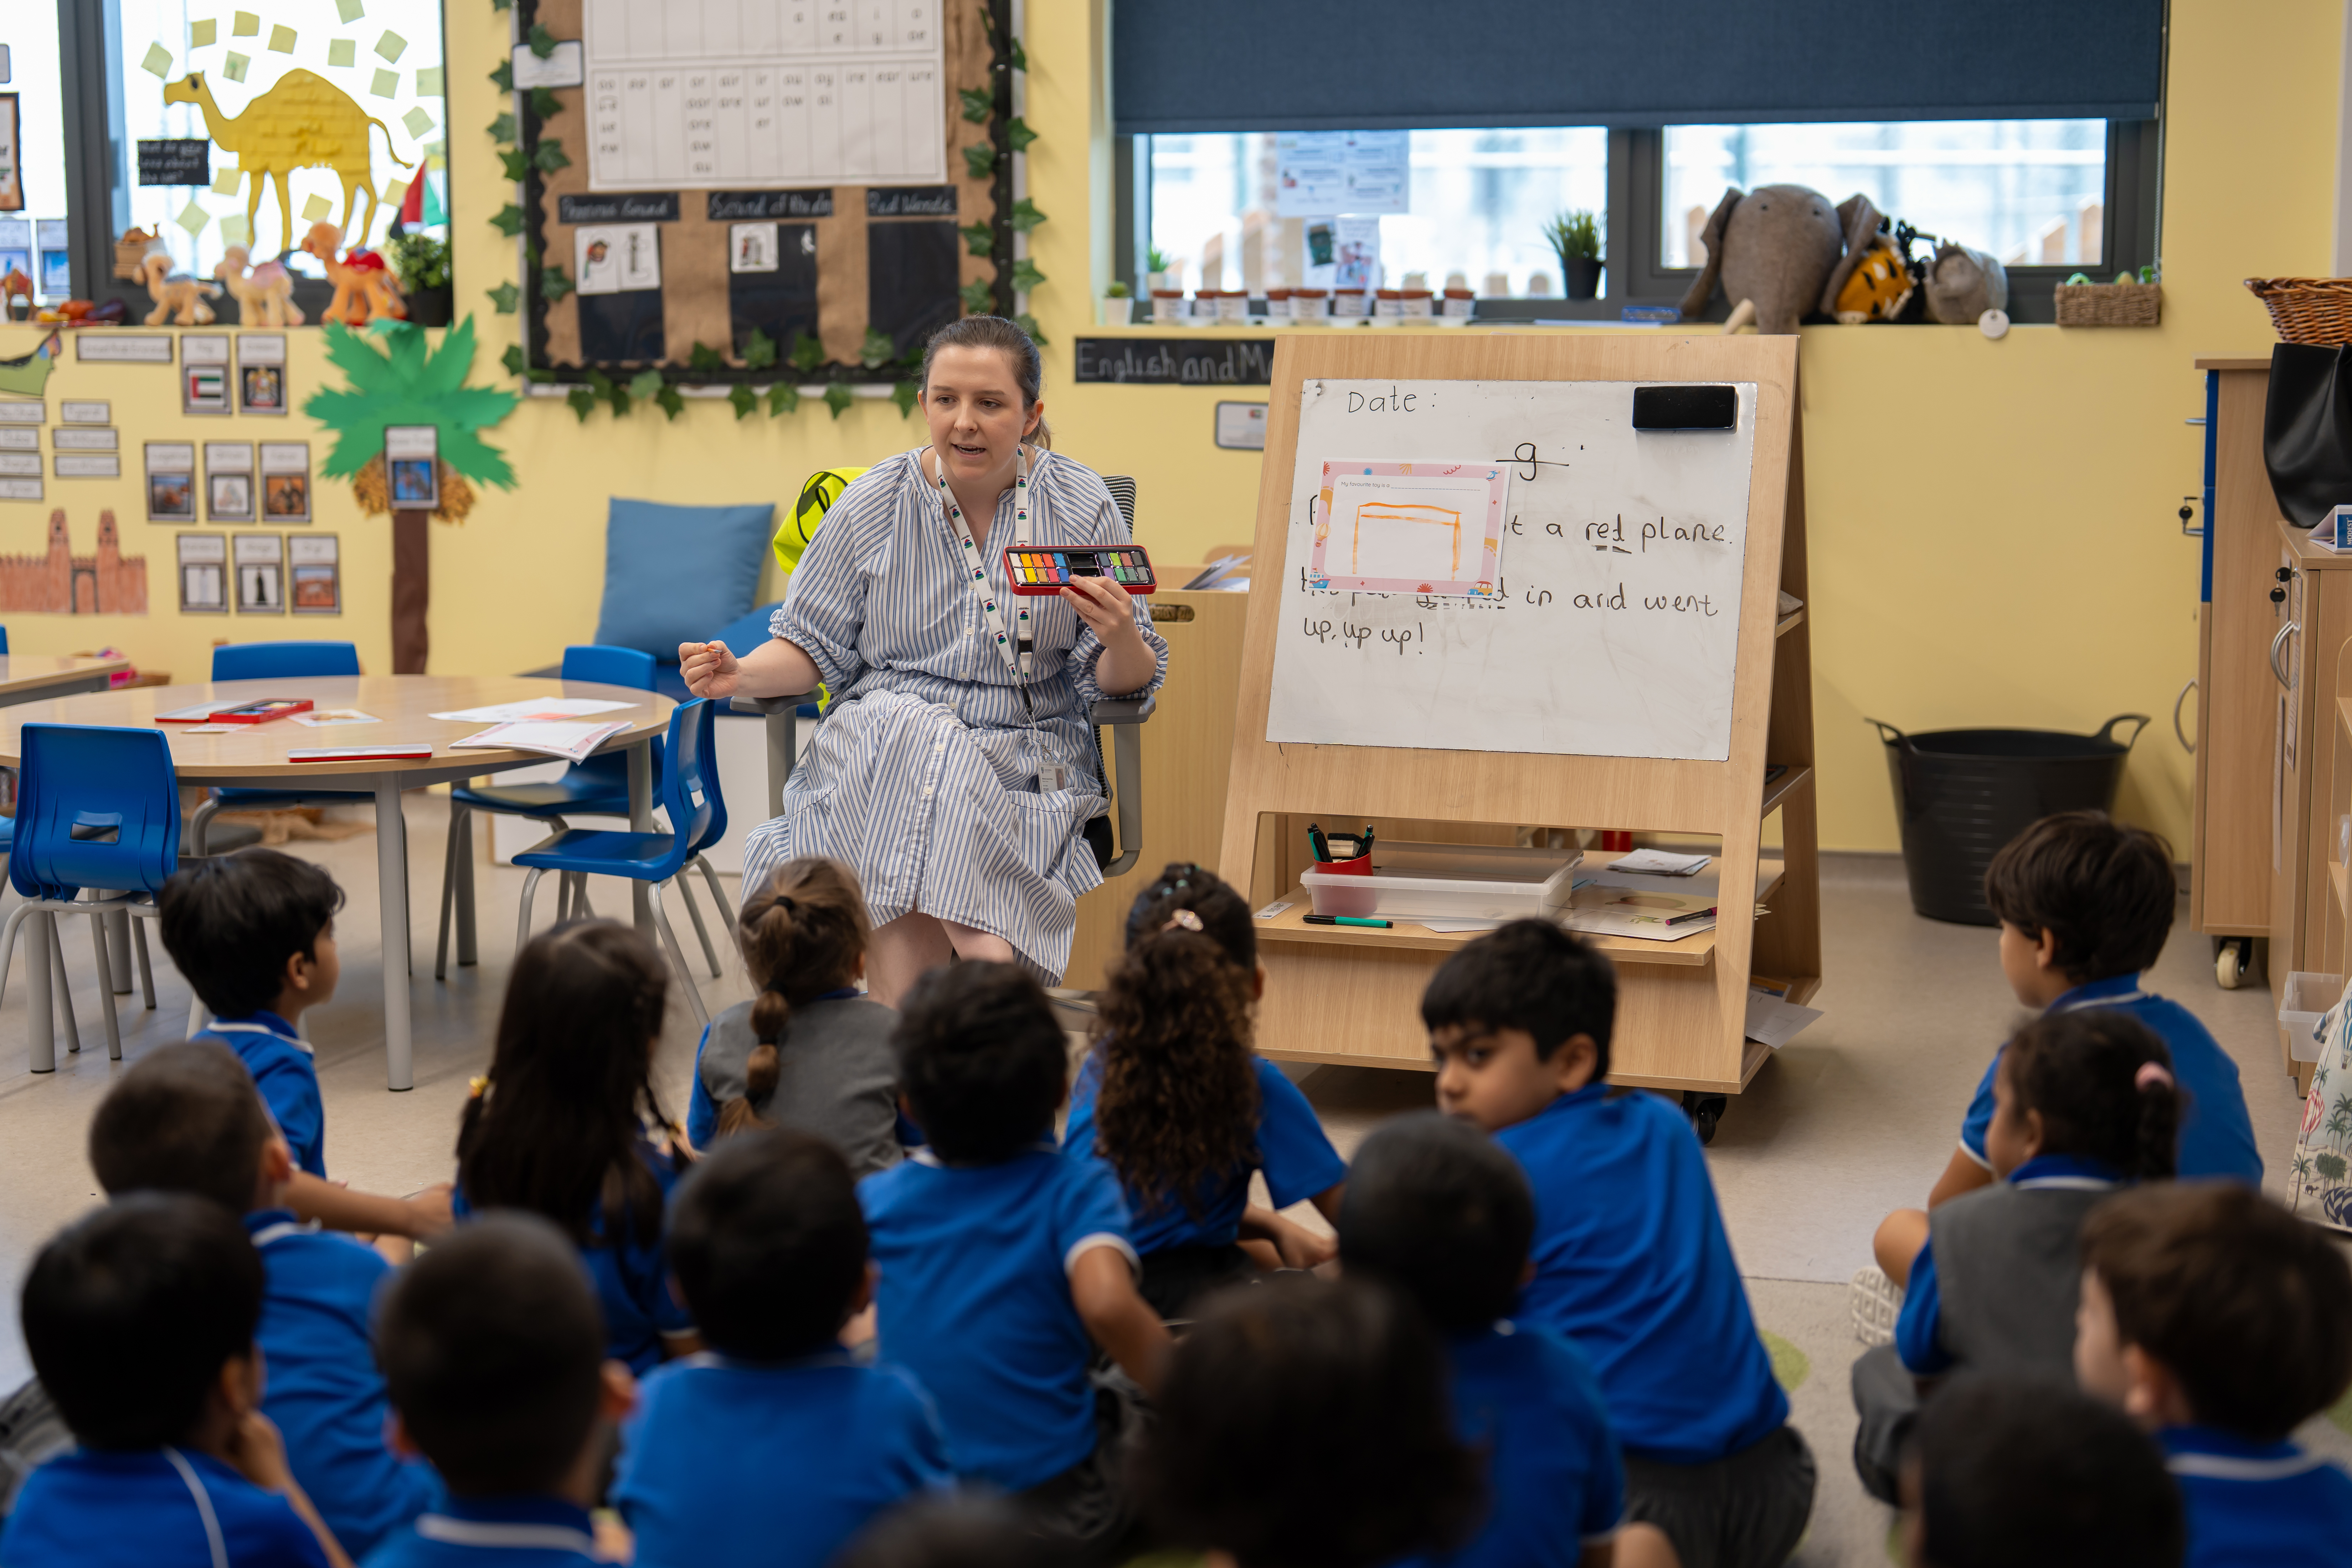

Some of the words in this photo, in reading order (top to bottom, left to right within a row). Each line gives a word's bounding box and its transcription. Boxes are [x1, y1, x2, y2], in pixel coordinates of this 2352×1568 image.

[1076, 343, 1176, 382] English
[1181, 344, 1236, 381] and
[1546, 523, 1564, 537] a
[1585, 513, 1625, 542] red
[1642, 516, 1733, 553] plane.
[1526, 585, 1552, 606] in
[1573, 582, 1627, 610] and
[1644, 594, 1718, 617] went
